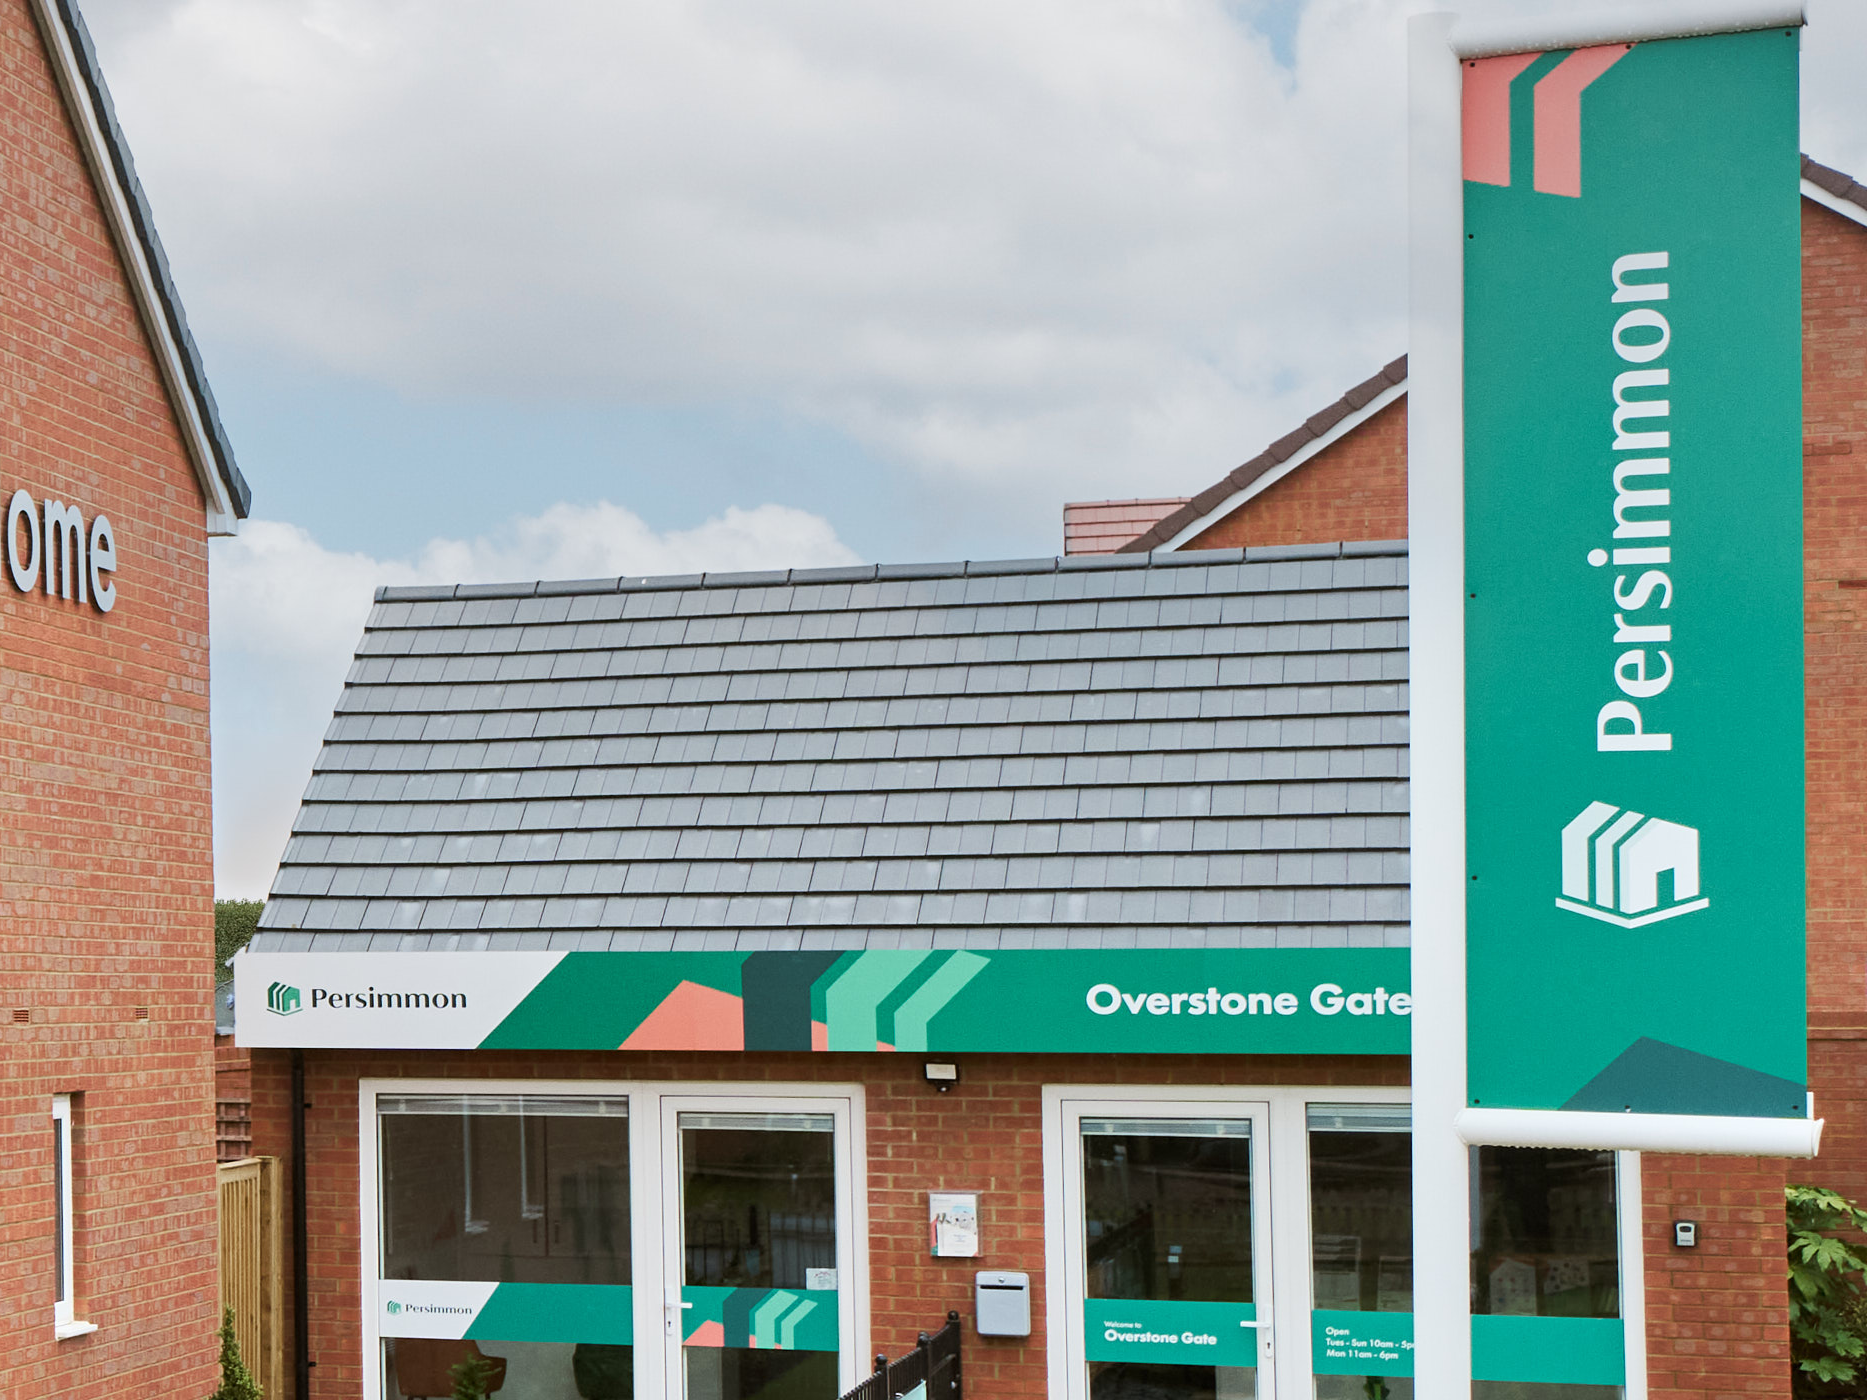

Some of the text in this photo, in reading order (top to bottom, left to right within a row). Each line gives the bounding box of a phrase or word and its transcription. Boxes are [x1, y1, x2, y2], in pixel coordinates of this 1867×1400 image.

[1587, 251, 1672, 752] Persimmon
[311, 986, 467, 1009] Persimmon
[1085, 982, 1412, 1016] Overstone Gate
[405, 1303, 472, 1315] Persimmon
[1103, 1320, 1134, 1329] Welcome
[1104, 1328, 1218, 1346] Overstone Gate
[1325, 1326, 1350, 1337] Open
[1325, 1337, 1345, 1347] Tues
[1351, 1338, 1368, 1348] Sun
[1369, 1339, 1394, 1348] 10am
[1326, 1348, 1346, 1358] Mon
[1348, 1349, 1372, 1359] 11am
[1379, 1351, 1399, 1361] 6pm
